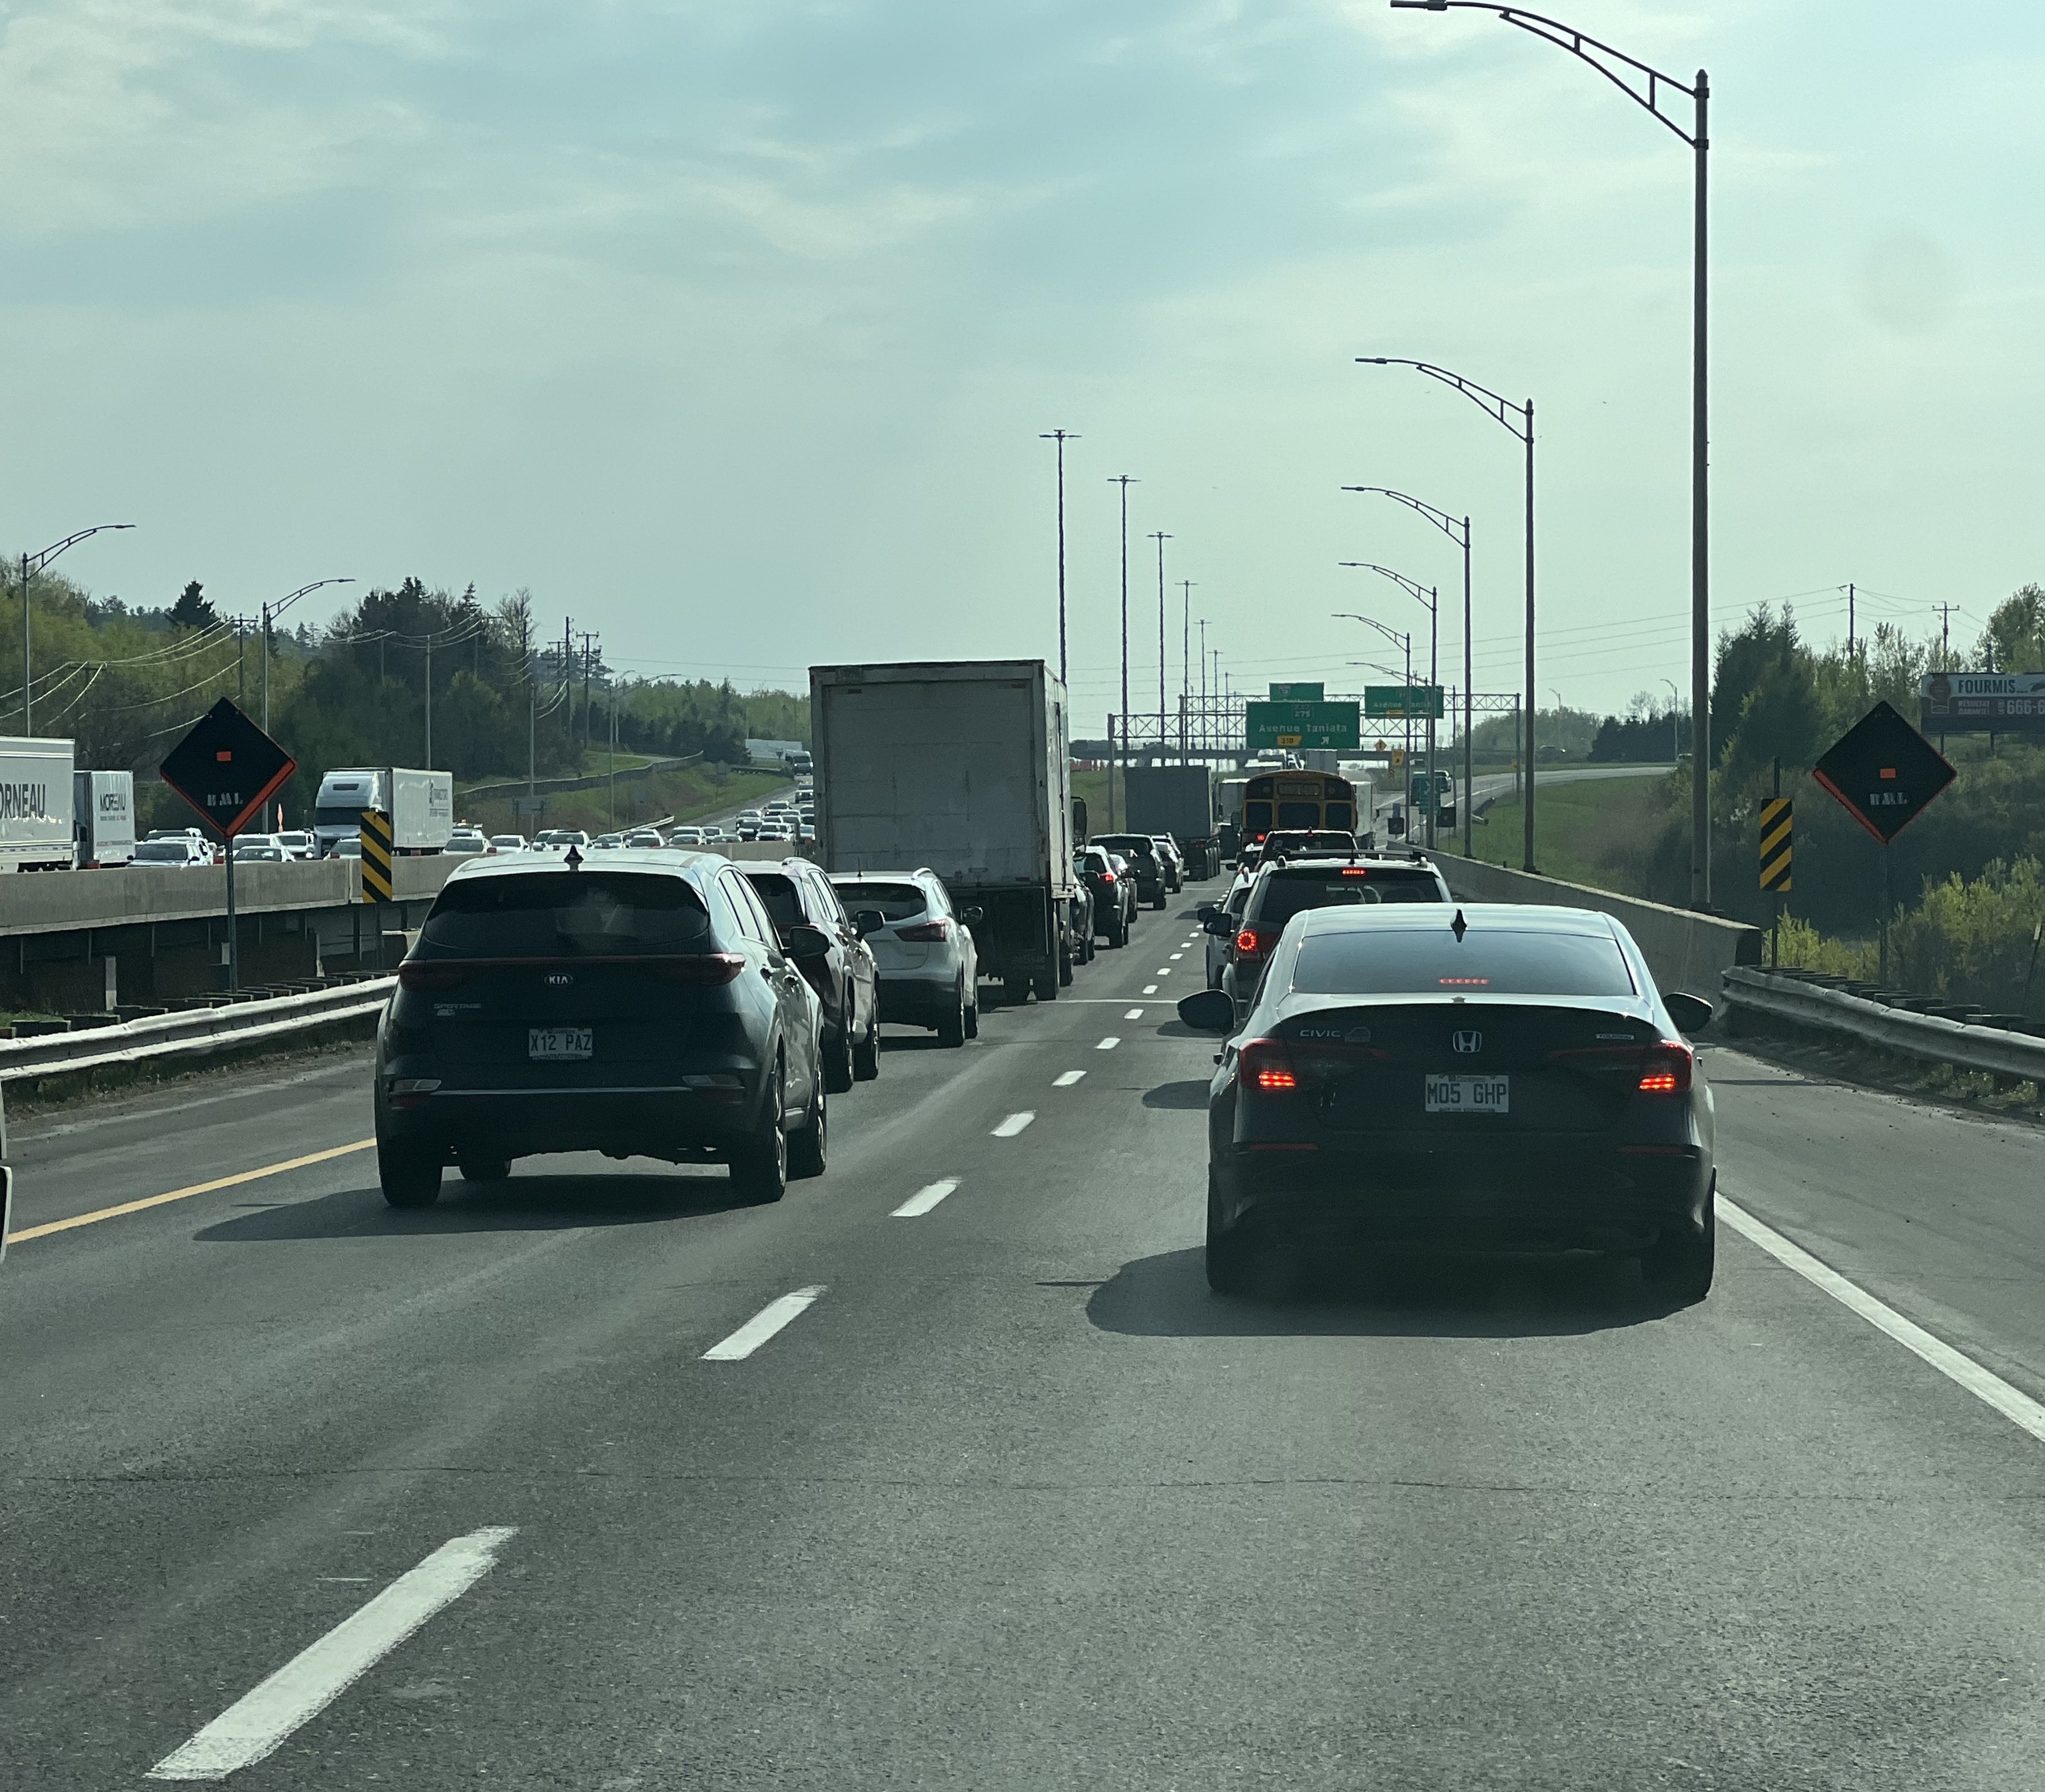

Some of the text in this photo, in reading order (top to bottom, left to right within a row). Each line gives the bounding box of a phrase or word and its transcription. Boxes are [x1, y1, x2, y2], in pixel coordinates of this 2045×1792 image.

[1258, 723, 1348, 733] Avenue Taniata
[548, 975, 569, 985] KIA
[1299, 1029, 1342, 1038] CIVIC
[530, 1034, 592, 1052] X12 PAZ
[1473, 1083, 1507, 1105] GHP
